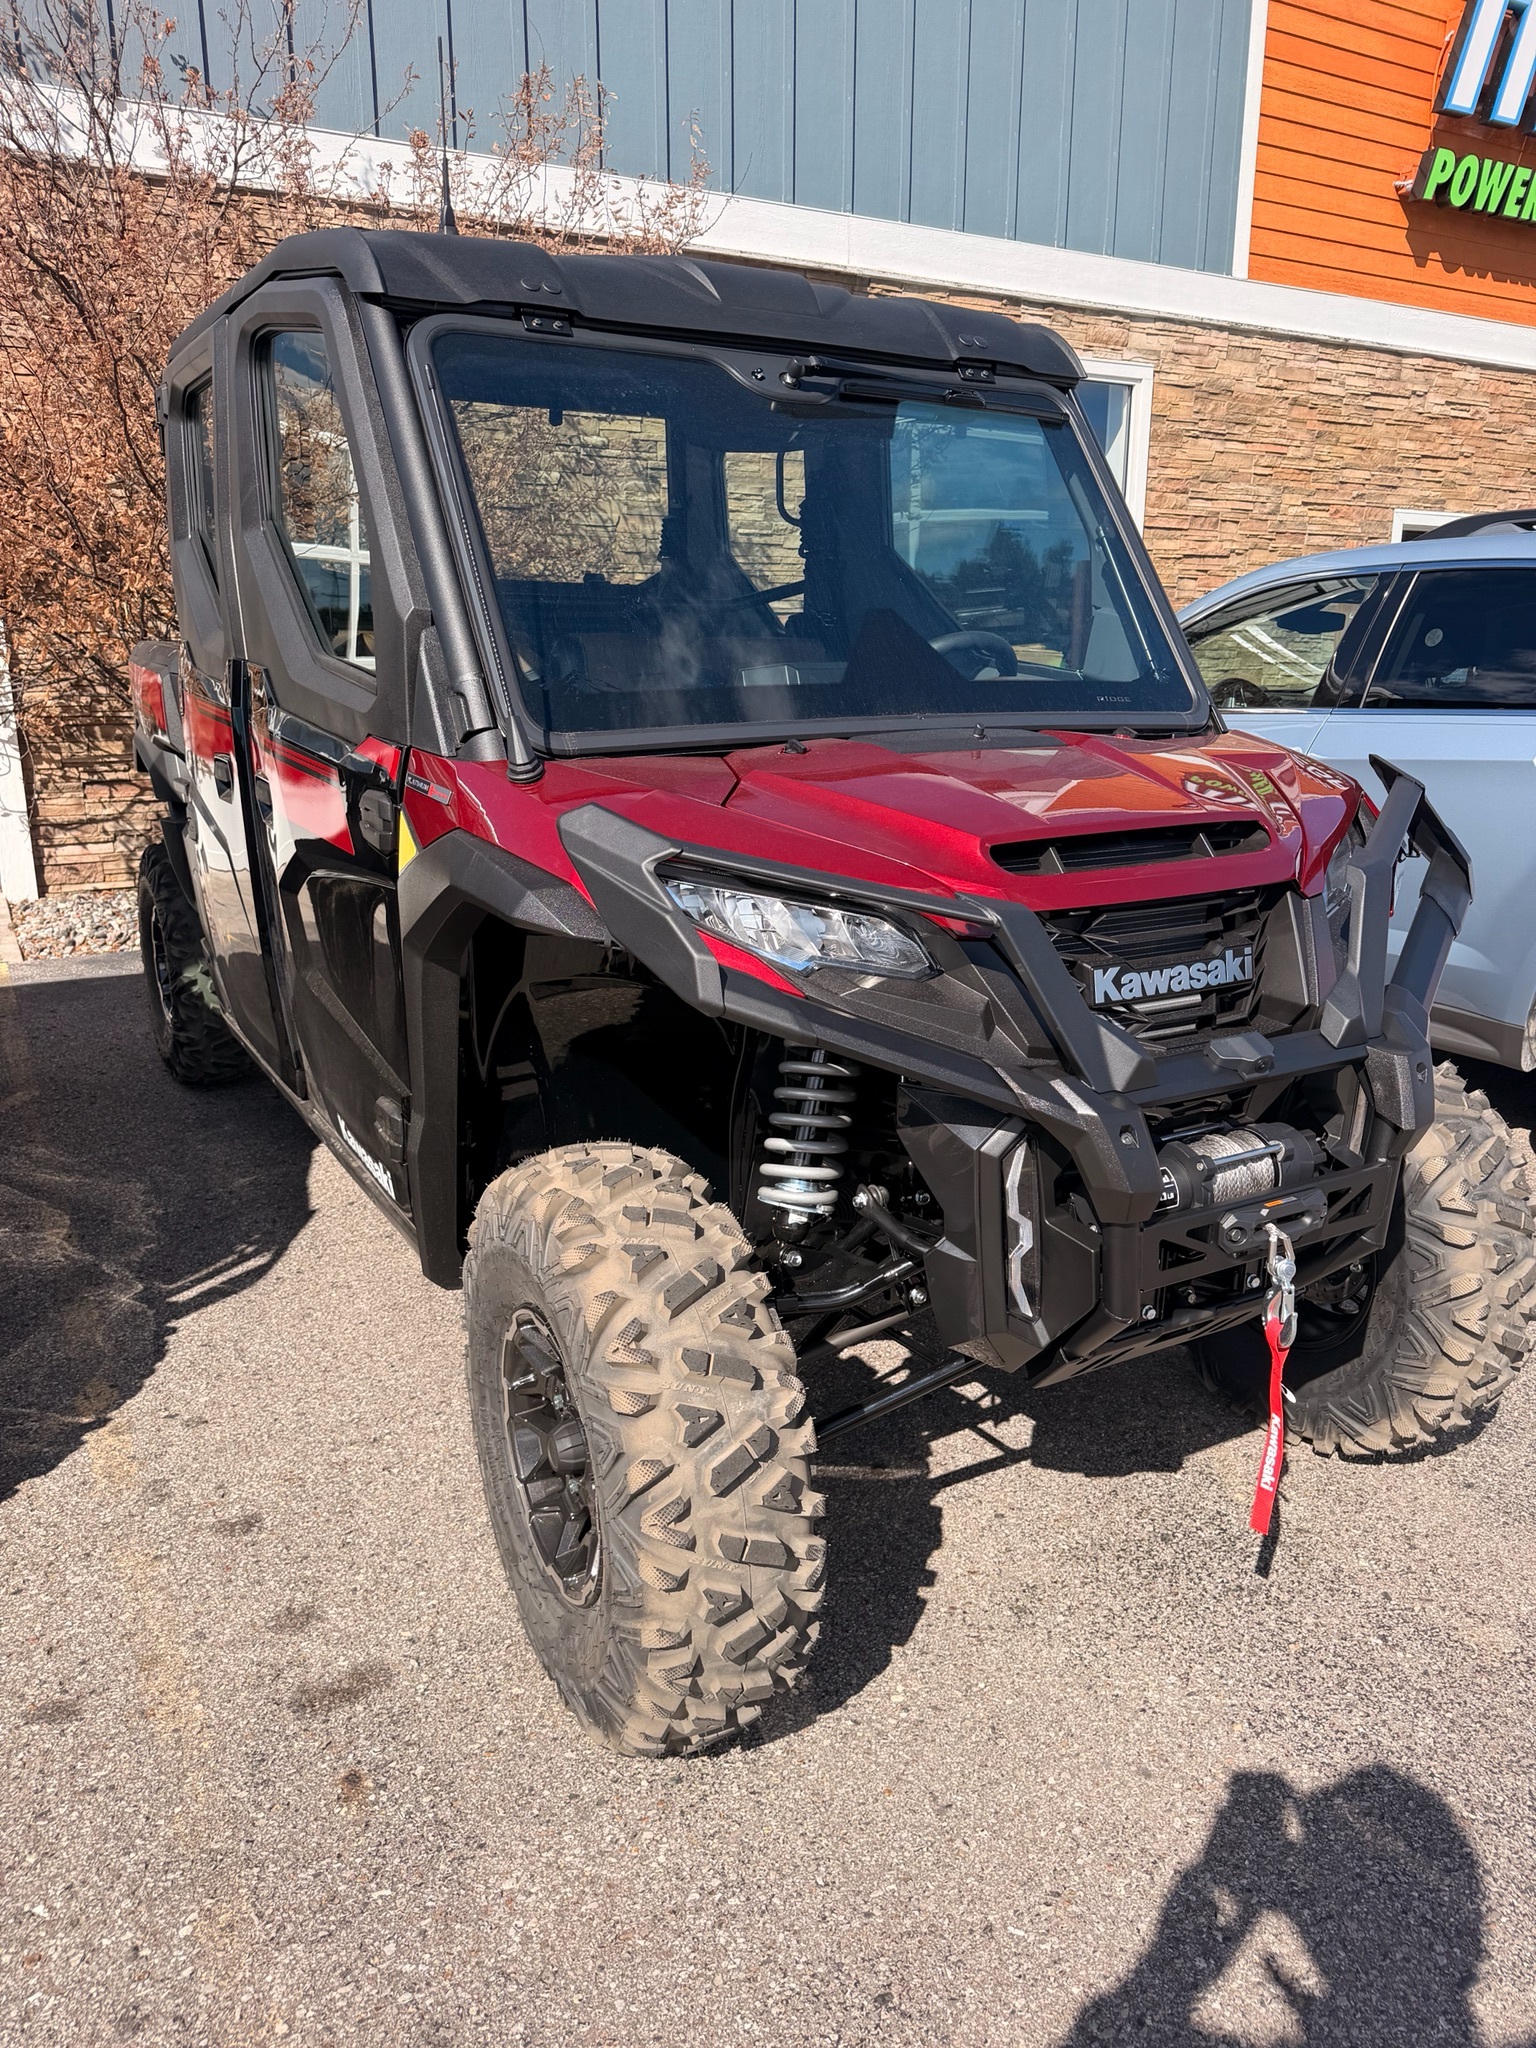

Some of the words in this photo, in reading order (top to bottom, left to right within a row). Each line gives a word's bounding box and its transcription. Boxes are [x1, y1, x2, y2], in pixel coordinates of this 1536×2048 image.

[1093, 946, 1253, 1004] Kawasaki
[336, 1112, 397, 1201] Kawasaki
[1260, 1412, 1281, 1492] Kawasaki
